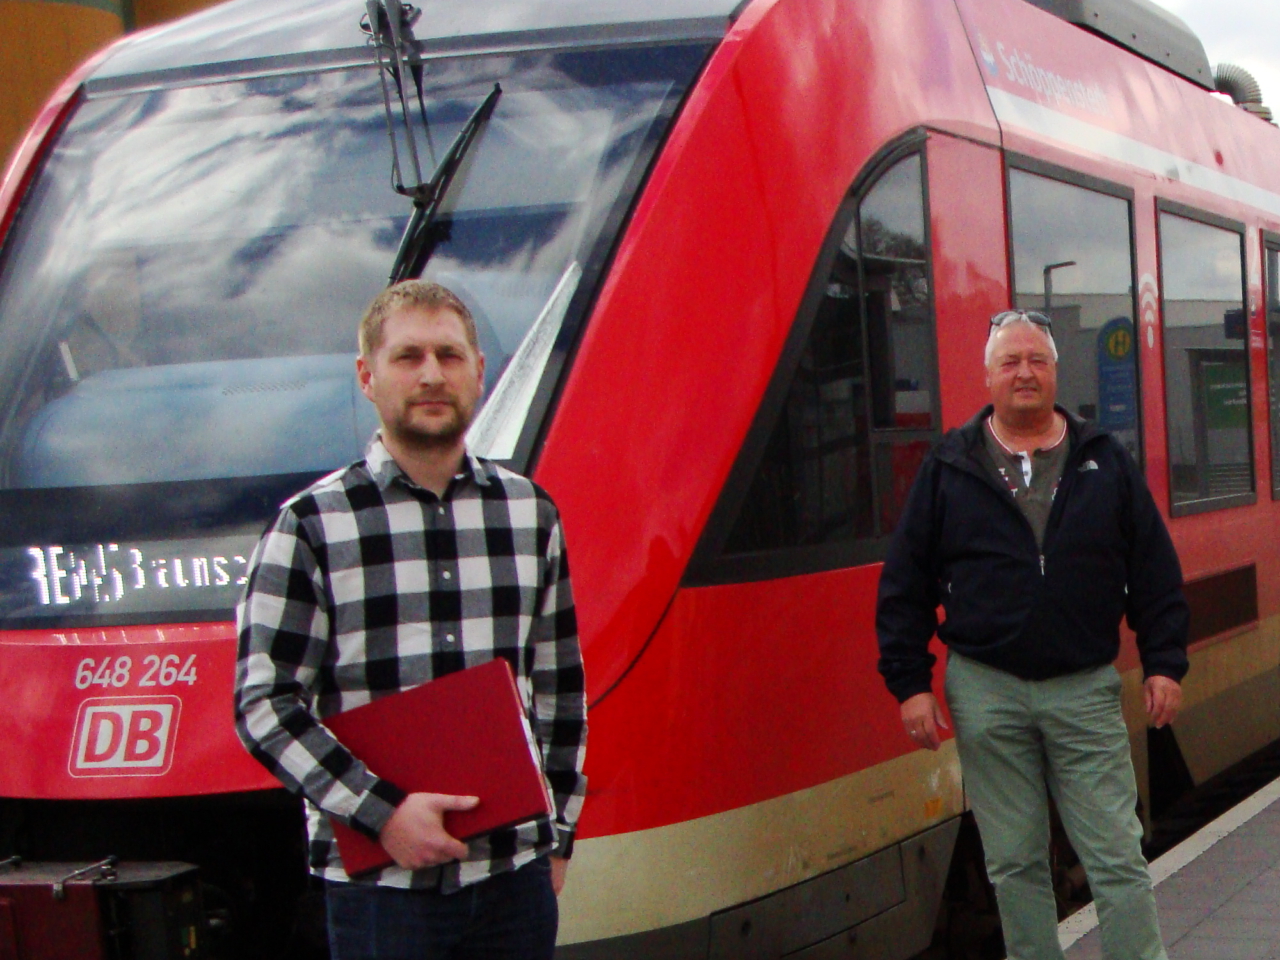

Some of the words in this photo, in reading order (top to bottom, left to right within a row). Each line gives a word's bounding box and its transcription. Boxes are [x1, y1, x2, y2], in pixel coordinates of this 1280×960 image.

[75, 656, 132, 690] 648
[138, 653, 197, 687] 264
[83, 708, 164, 763] DB
